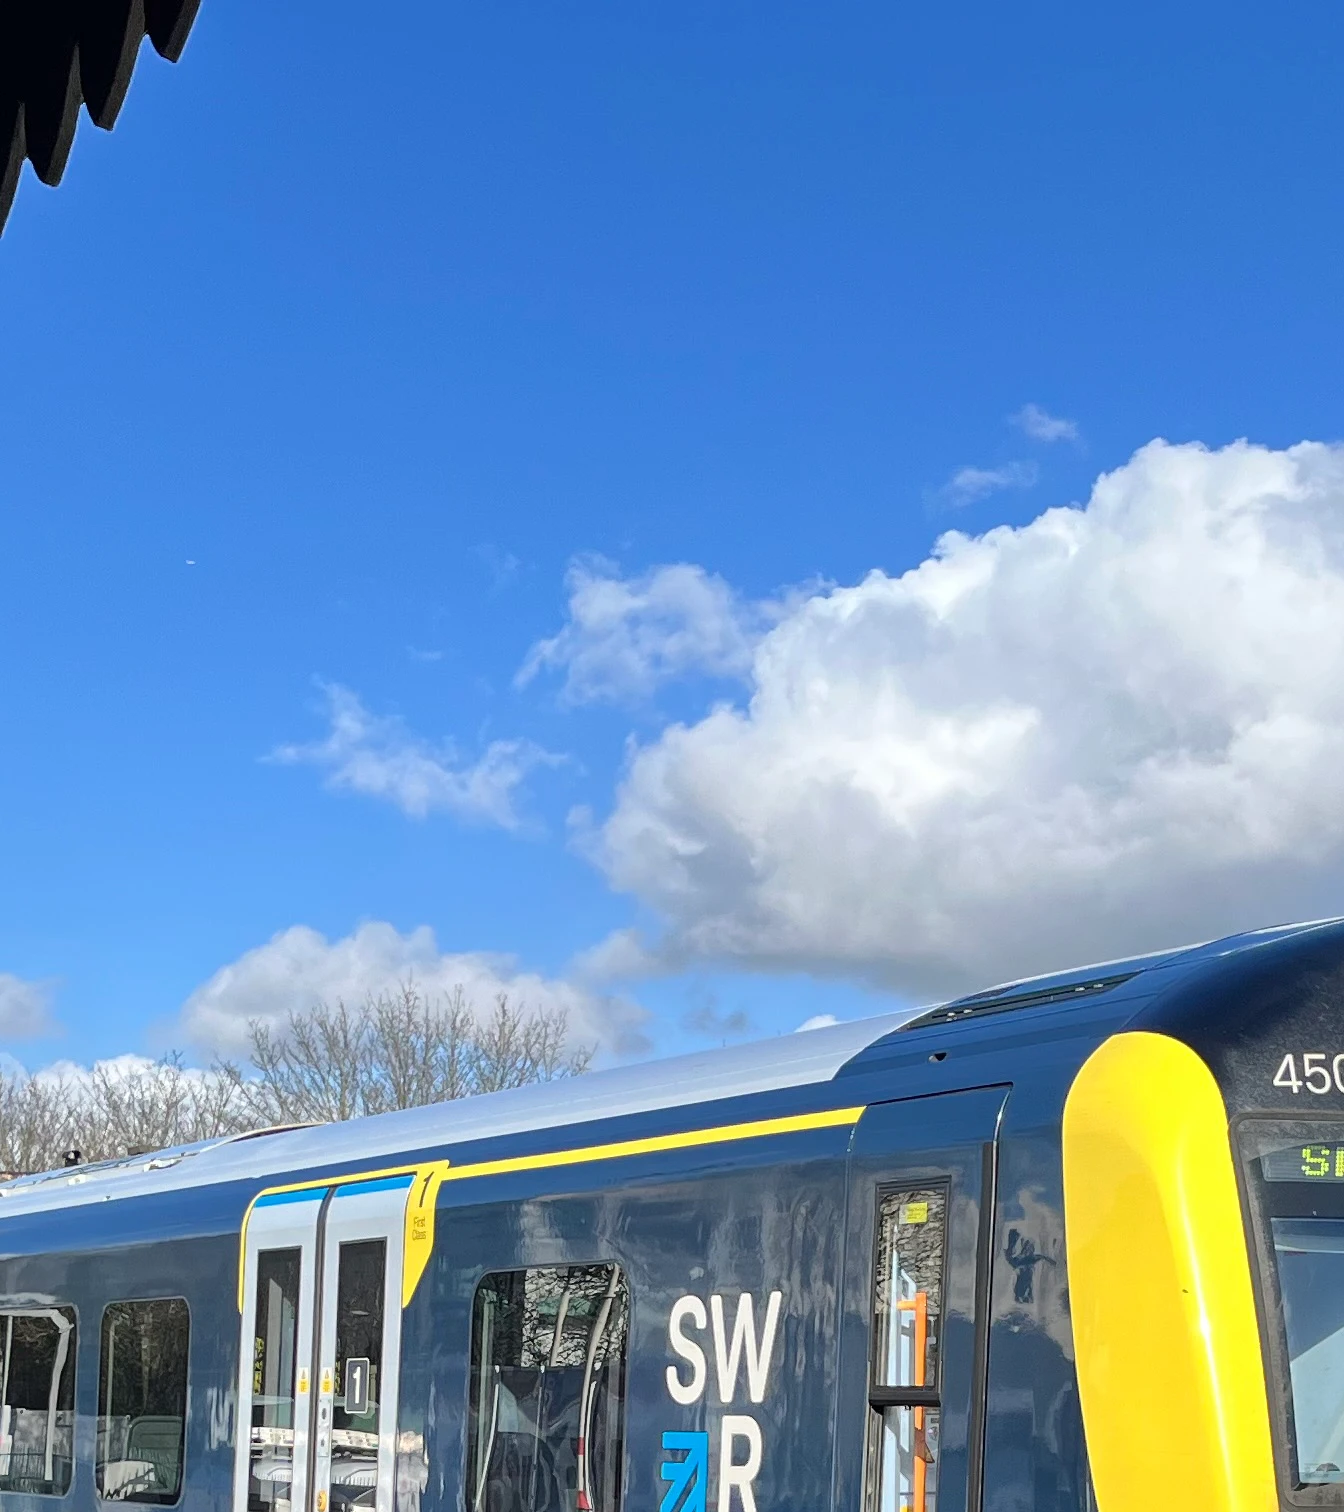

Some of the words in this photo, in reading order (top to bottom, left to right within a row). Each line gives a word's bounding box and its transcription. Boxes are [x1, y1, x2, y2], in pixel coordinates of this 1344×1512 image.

[419, 1171, 434, 1208] 1
[666, 1290, 782, 1405] SW
[352, 1366, 361, 1404] 1
